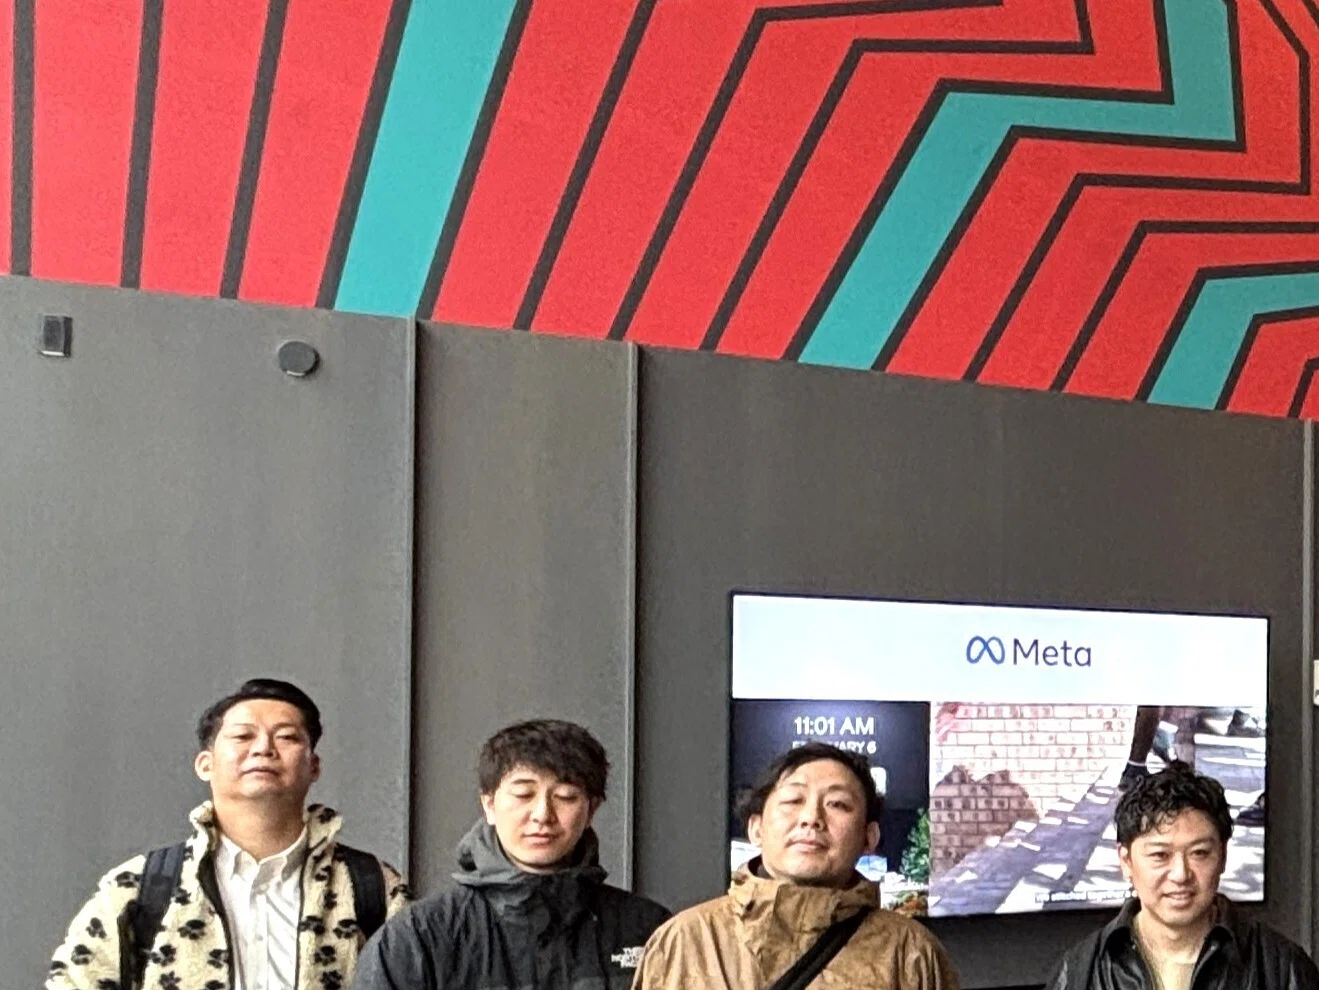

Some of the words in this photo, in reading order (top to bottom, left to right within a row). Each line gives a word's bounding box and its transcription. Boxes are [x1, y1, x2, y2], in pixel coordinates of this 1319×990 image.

[1013, 638, 1091, 667] Meta
[794, 716, 835, 736] 11:01
[839, 716, 875, 736] AM
[866, 741, 877, 754] 6
